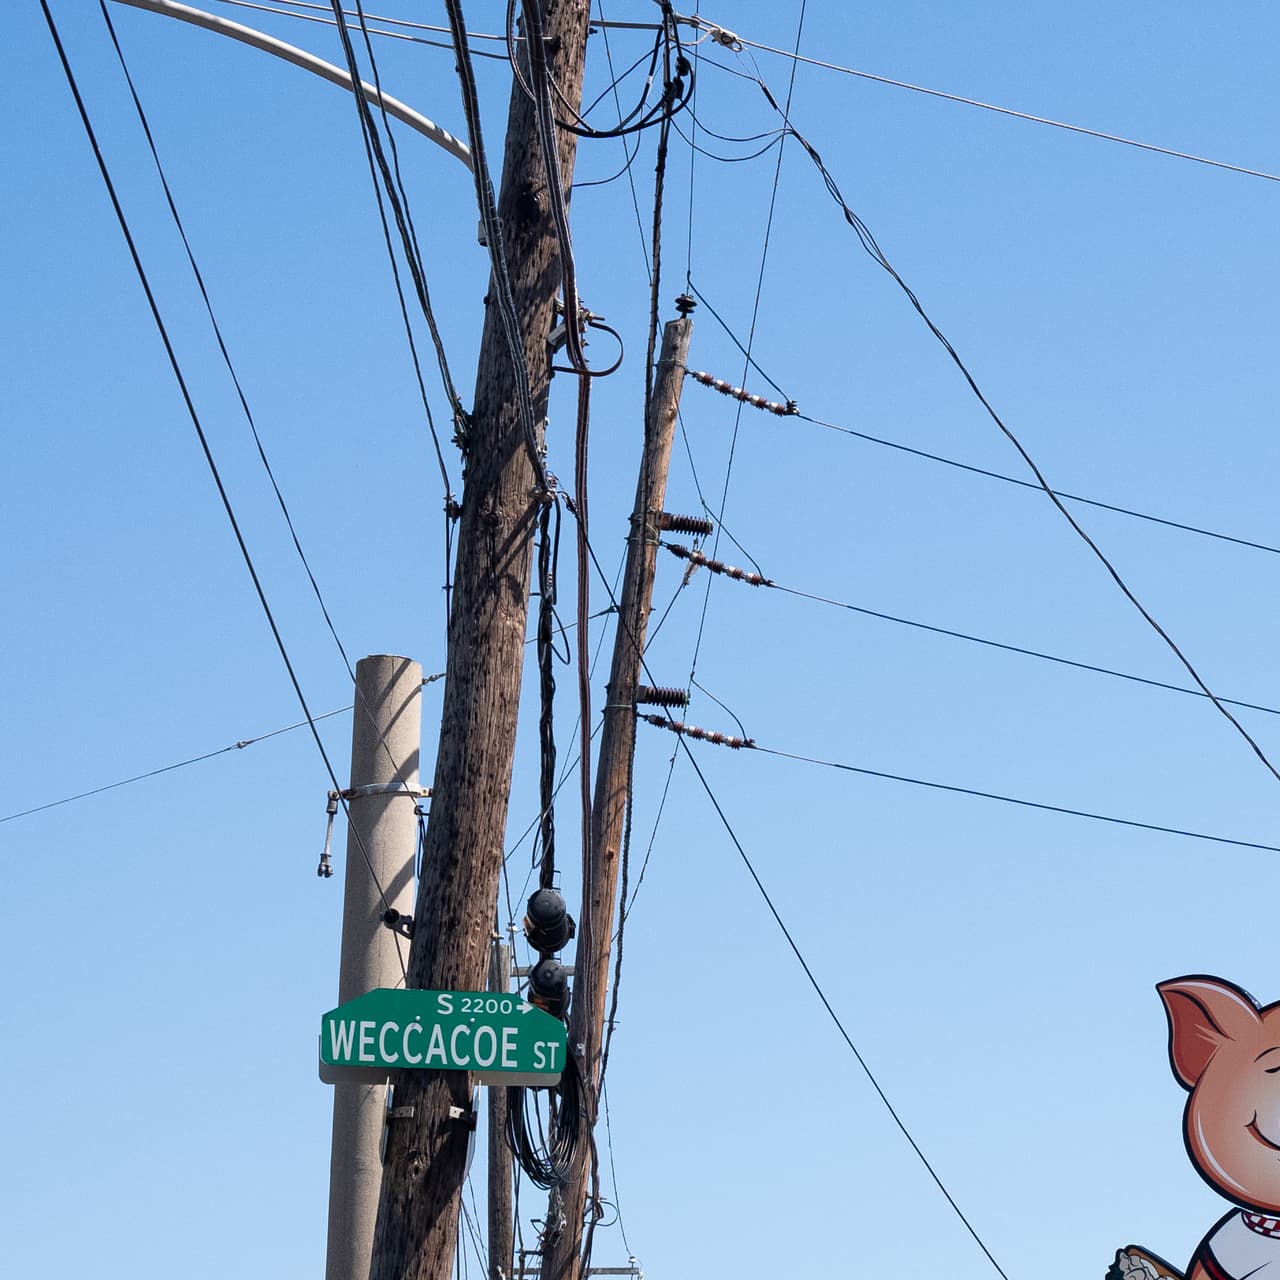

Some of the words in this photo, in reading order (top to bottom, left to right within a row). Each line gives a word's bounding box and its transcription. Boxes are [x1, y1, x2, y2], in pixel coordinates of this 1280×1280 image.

[436, 993, 454, 1015] S
[460, 998, 513, 1015] 2200
[329, 1019, 519, 1068] WECCACOE
[532, 1041, 560, 1070] ST
